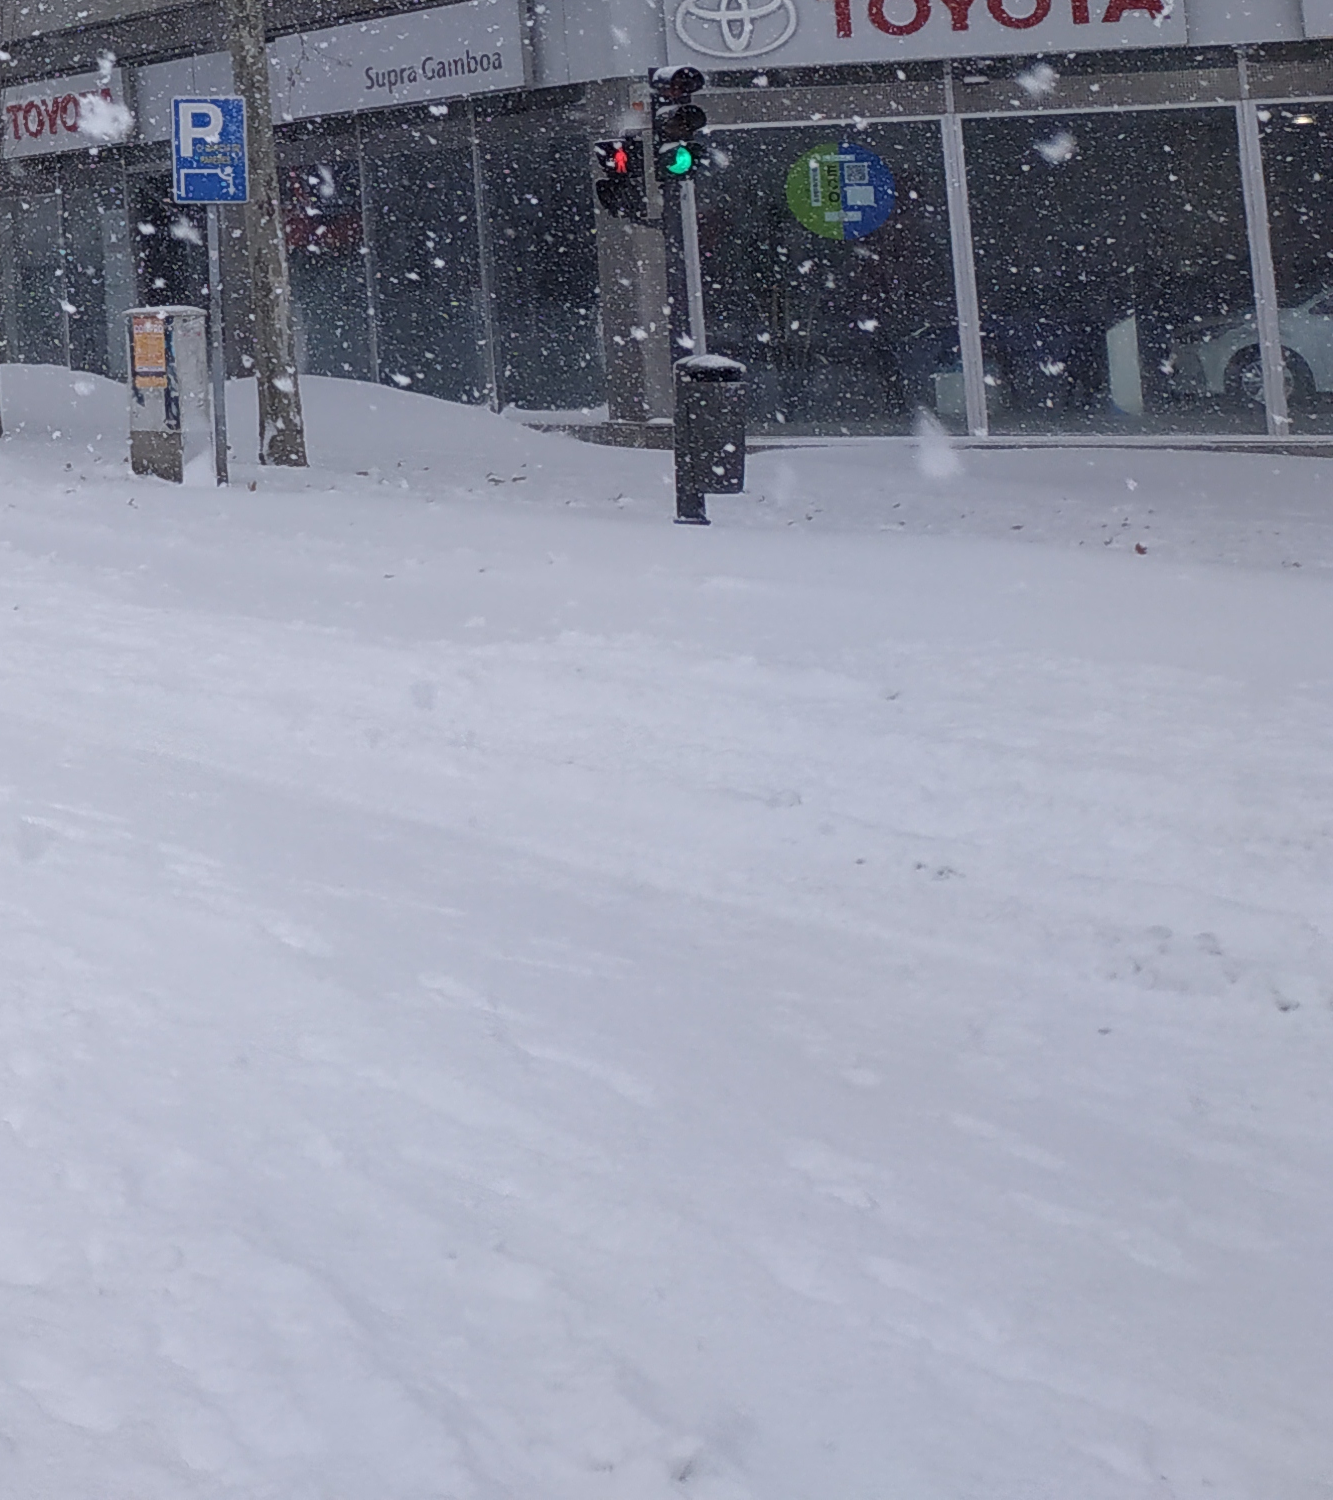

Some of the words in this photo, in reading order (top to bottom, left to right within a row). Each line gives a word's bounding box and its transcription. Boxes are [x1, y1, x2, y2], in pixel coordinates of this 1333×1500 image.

[365, 66, 417, 94] Supra
[421, 50, 503, 81] Gamboa
[6, 88, 114, 140] TOYO
[179, 103, 223, 156] P
